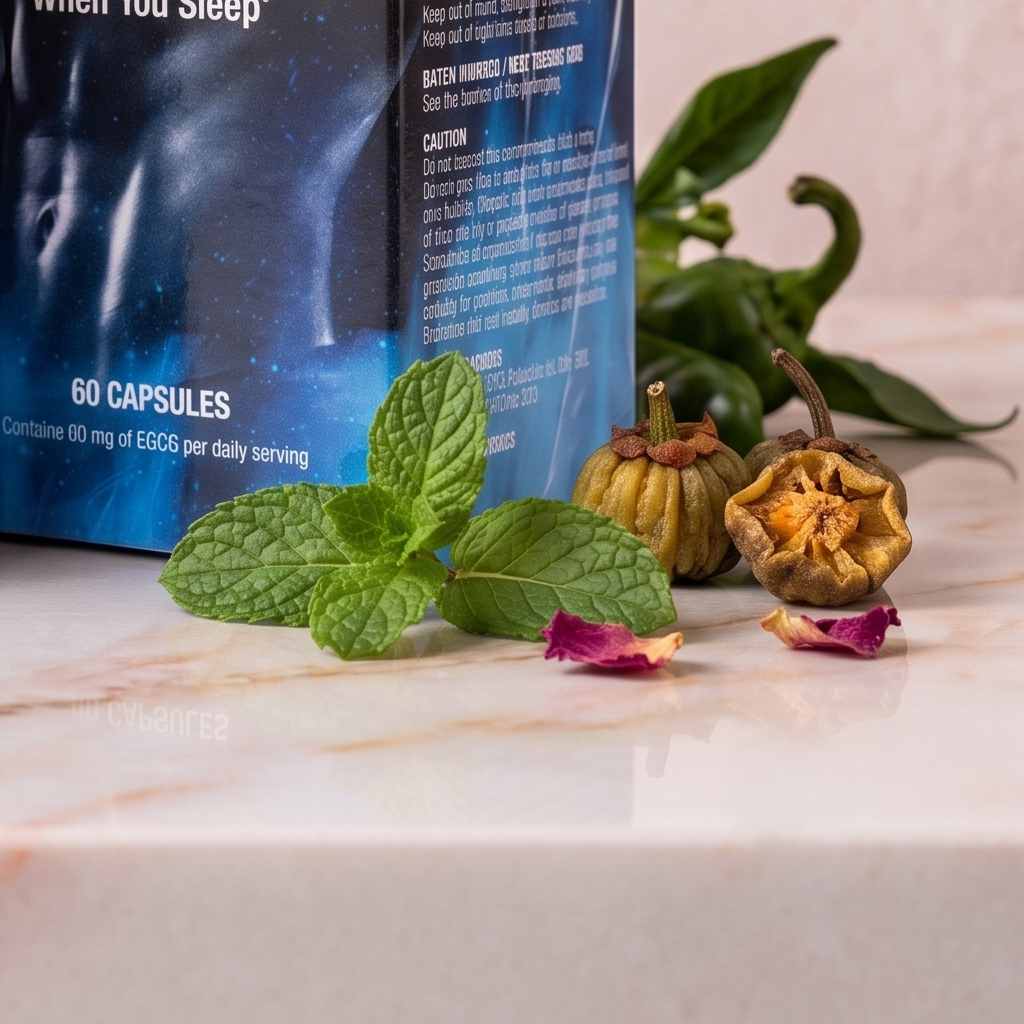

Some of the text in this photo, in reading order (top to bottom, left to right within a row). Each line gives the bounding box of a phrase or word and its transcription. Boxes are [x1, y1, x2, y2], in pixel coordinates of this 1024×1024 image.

[422, 5, 445, 26] Keep
[448, 3, 463, 21] out
[464, 0, 473, 18] of
[448, 27, 463, 44] out
[464, 24, 473, 42] of
[423, 68, 456, 89] BATEN
[423, 93, 440, 113] See
[444, 89, 458, 108] the
[423, 127, 467, 153] CAUTION
[71, 377, 231, 420] 60 CAPSULES
[91, 429, 114, 450] mg
[118, 429, 133, 448] of
[183, 439, 208, 458] per
[212, 439, 247, 464] daily
[252, 445, 309, 470] serving
